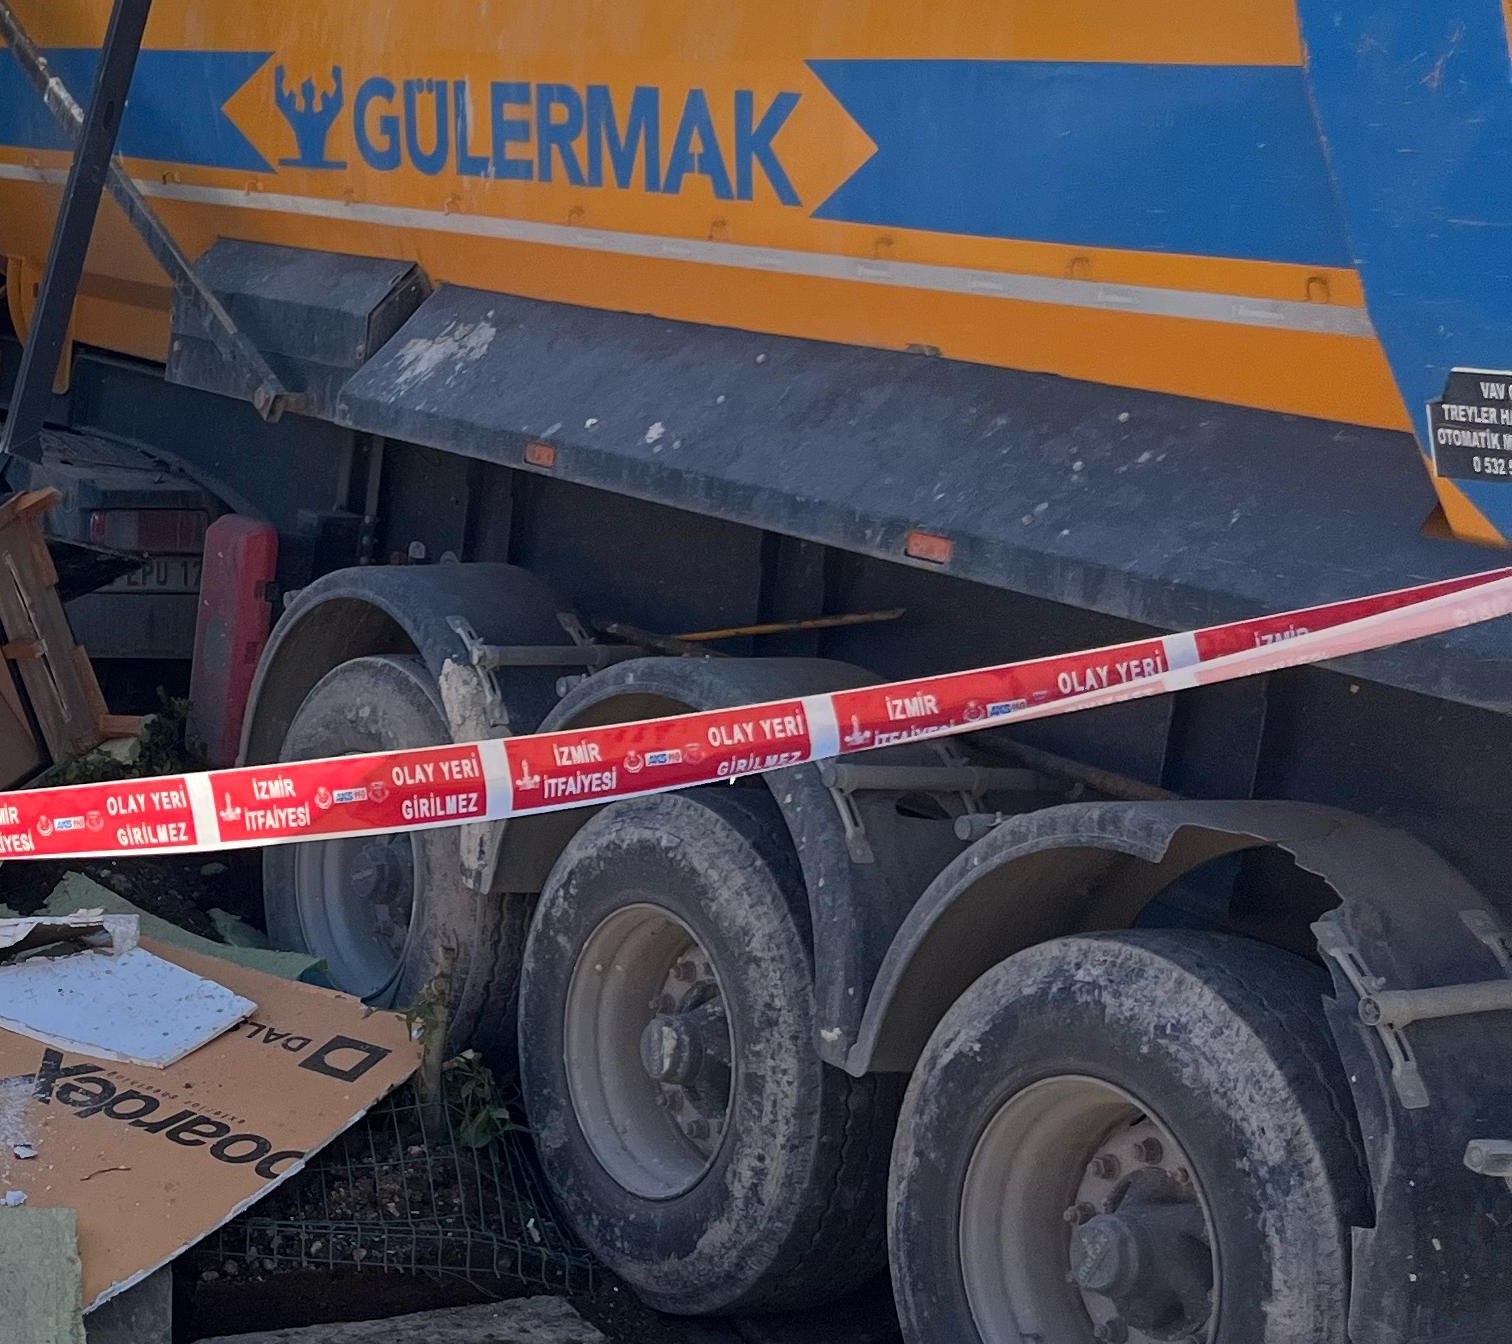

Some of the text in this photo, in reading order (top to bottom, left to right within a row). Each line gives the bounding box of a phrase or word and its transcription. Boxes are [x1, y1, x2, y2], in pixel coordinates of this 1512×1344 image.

[354, 75, 803, 208] GÜLERMAK
[1479, 382, 1506, 400] VAV
[1441, 404, 1498, 425] TREYLER
[1437, 428, 1501, 450] OTOMATİK
[1472, 456, 1481, 473] 0
[1483, 457, 1506, 475] 532
[1057, 649, 1165, 695] OLAY YERİ
[885, 691, 939, 720] İZMİR
[707, 709, 805, 747] OLAY YERİ
[553, 739, 602, 766] İZMİR
[391, 752, 480, 786] OLAY YERİ
[543, 767, 617, 799] İTFAİYESİ
[106, 785, 187, 816] OLAY YERİ
[252, 774, 296, 800] İZMİR
[244, 802, 311, 831] İTFAİYESİ
[401, 792, 478, 820] GİRİLMEZ
[117, 823, 189, 847] GİRİLMEZ
[232, 1017, 314, 1053] DAL
